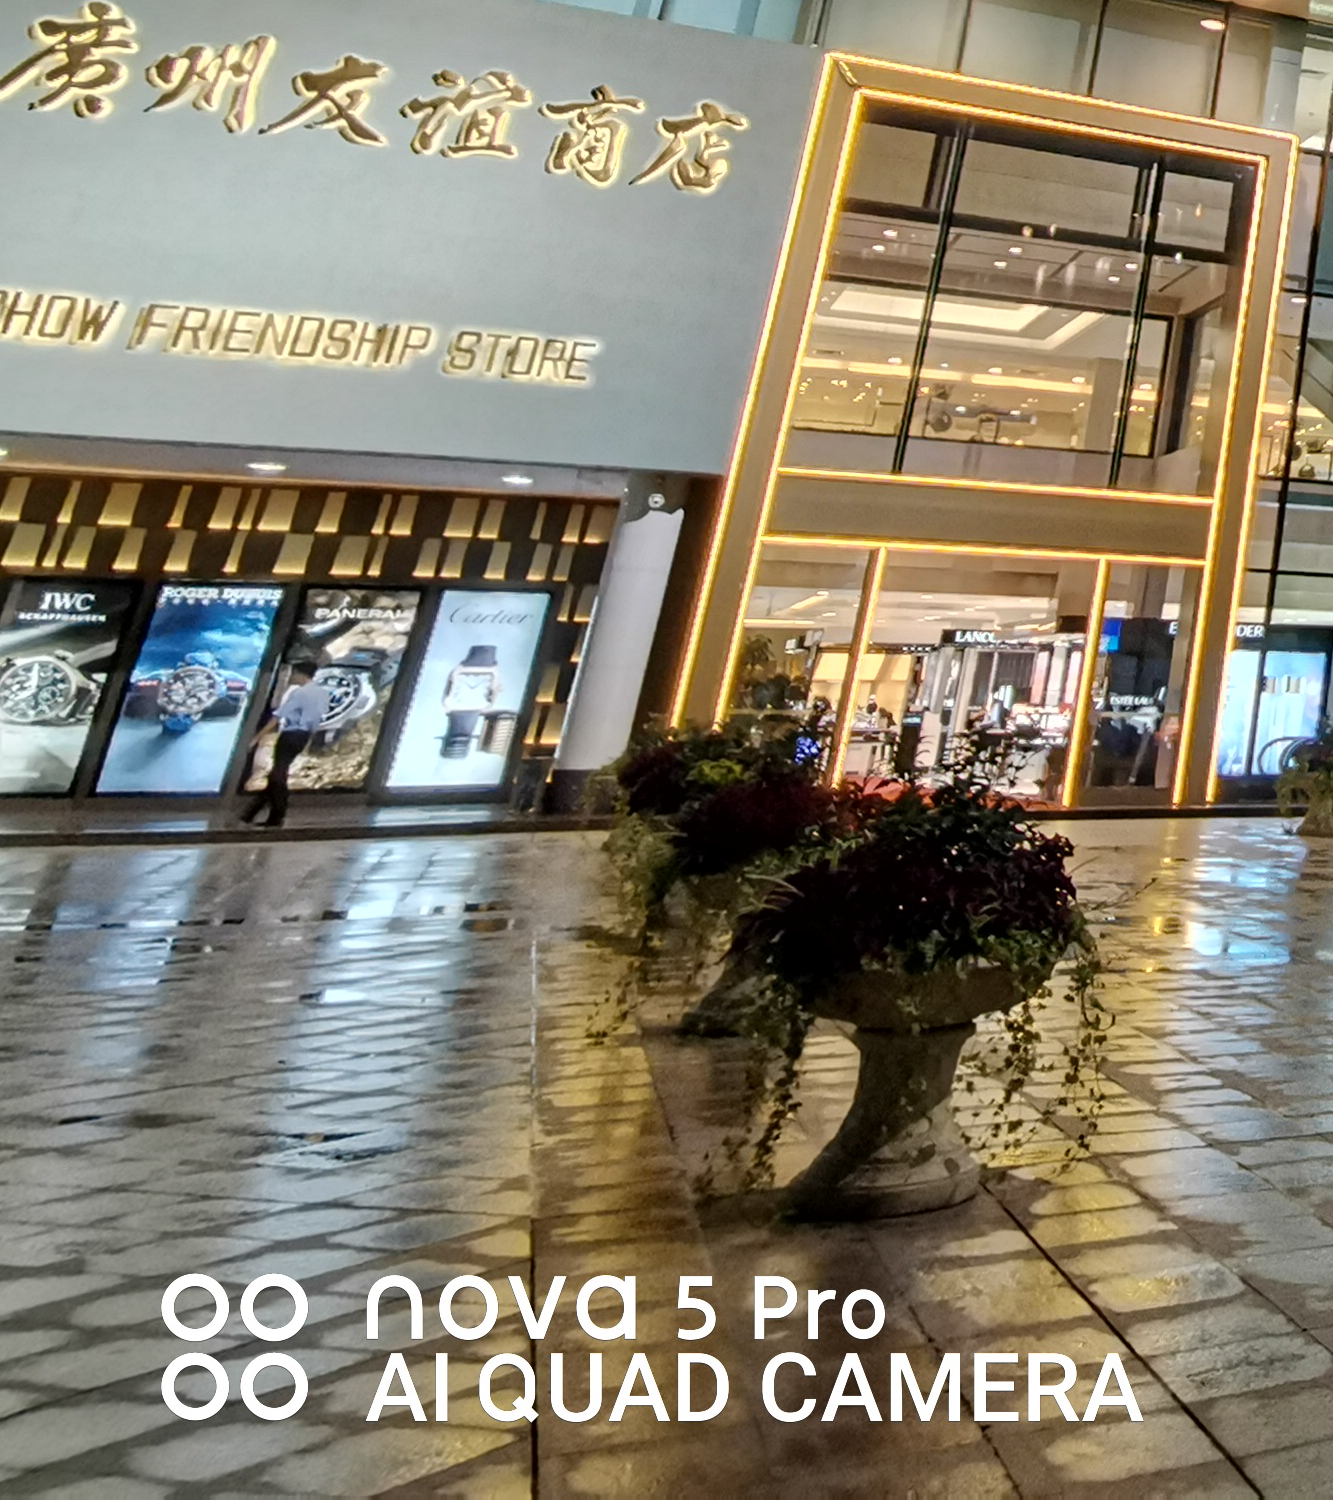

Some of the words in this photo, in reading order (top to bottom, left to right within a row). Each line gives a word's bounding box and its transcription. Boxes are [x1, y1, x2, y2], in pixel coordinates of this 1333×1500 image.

[125, 302, 432, 367] FRIENDSHIP
[444, 329, 598, 382] STORE
[39, 591, 96, 612] IWC
[161, 586, 219, 599] ROGER
[449, 602, 534, 626] Cartier
